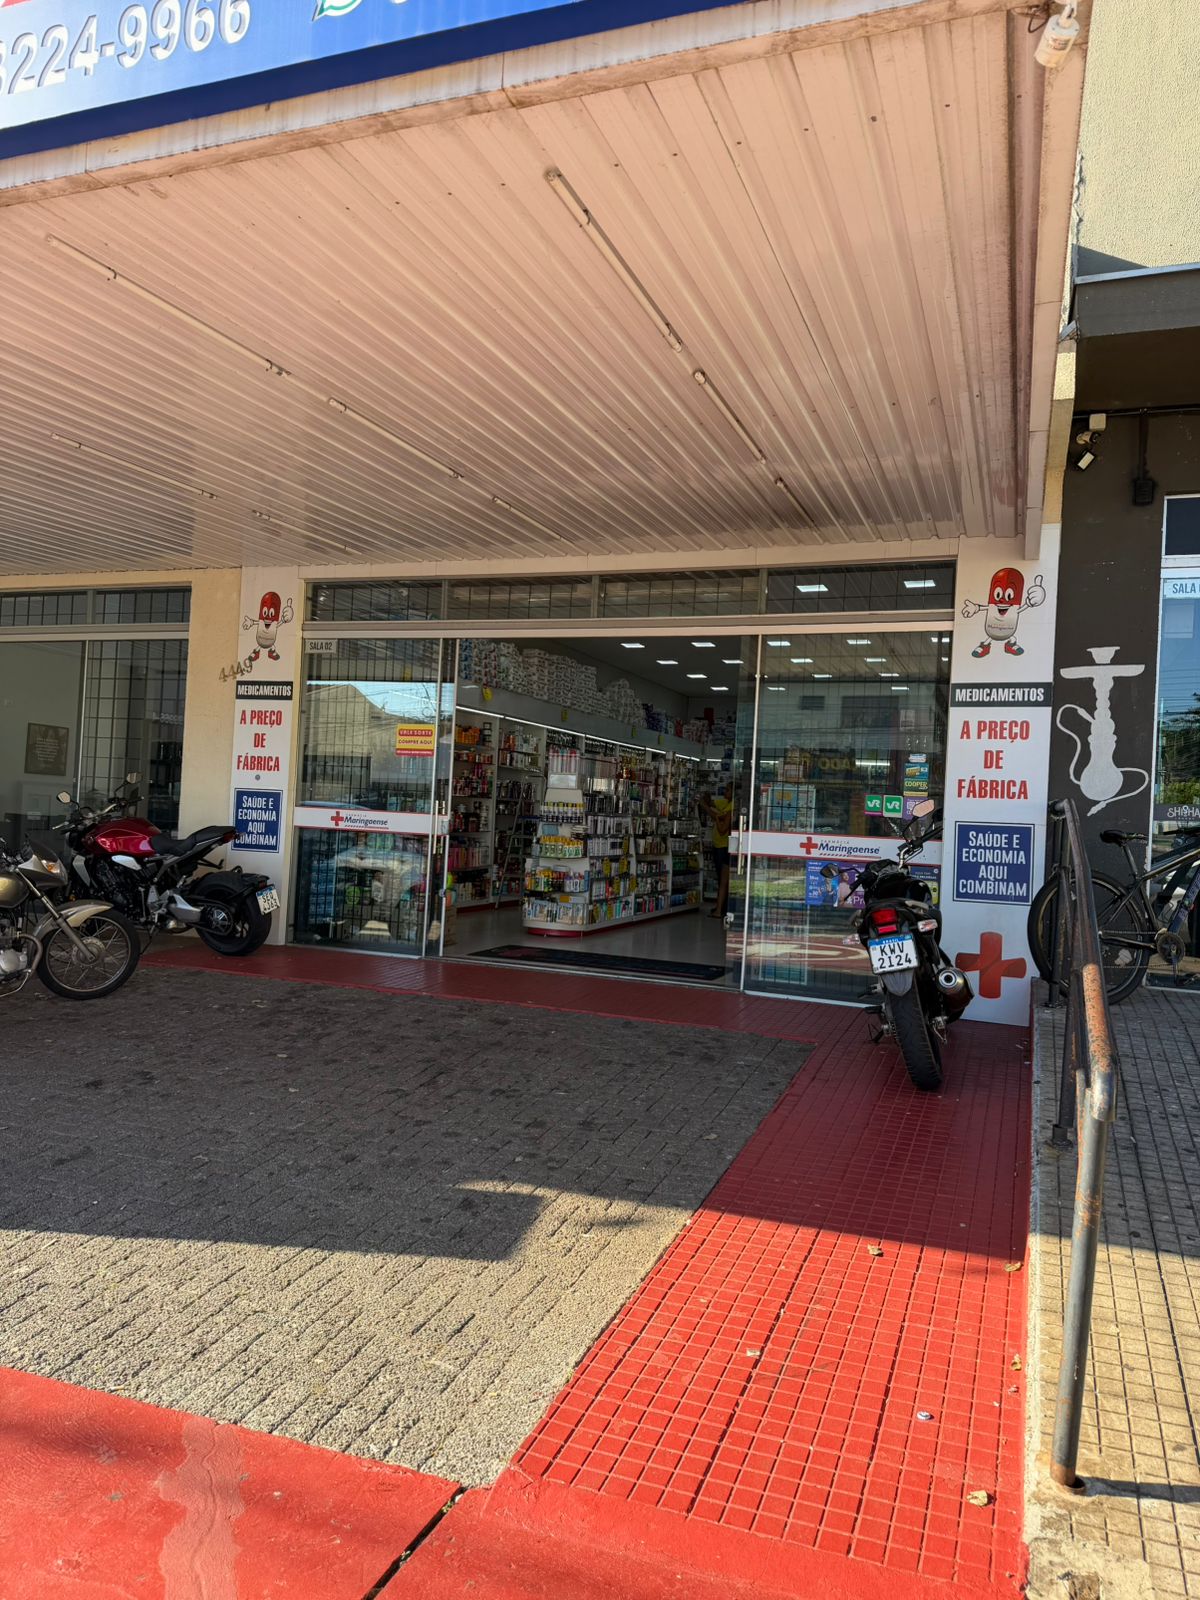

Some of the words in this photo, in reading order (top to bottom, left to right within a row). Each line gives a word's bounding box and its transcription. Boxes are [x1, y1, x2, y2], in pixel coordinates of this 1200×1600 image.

[0, 0, 251, 94] 224-9966
[1172, 582, 1197, 594] SALA
[309, 641, 324, 651] SALA
[325, 641, 333, 651] 02
[218, 657, 253, 682] 4449
[237, 684, 292, 697] MEDICAMENTOS
[955, 688, 1045, 702] MEDICAMENTOS
[240, 709, 247, 725] A
[250, 709, 283, 728] PREÇO
[960, 720, 971, 740] A
[977, 720, 1031, 743] PREÇO
[253, 732, 267, 748] DE
[237, 752, 280, 772] FÁBRICA
[983, 750, 1004, 769] DE
[957, 775, 1028, 800] FÁBRICA
[242, 795, 267, 809] SAÚDE
[268, 798, 275, 809] E
[237, 809, 277, 822] ECONOMIA
[344, 816, 388, 826] Maringaense
[247, 821, 266, 835] AQUI
[968, 831, 1009, 848] SAÚDE
[1013, 834, 1020, 848] E
[818, 843, 880, 855] Maringaense
[962, 848, 1026, 865] ECONOMIA
[978, 865, 1008, 881] AQUI
[959, 879, 1027, 897] COMBINAM
[880, 942, 904, 957] KWV
[878, 953, 912, 969] 2124
